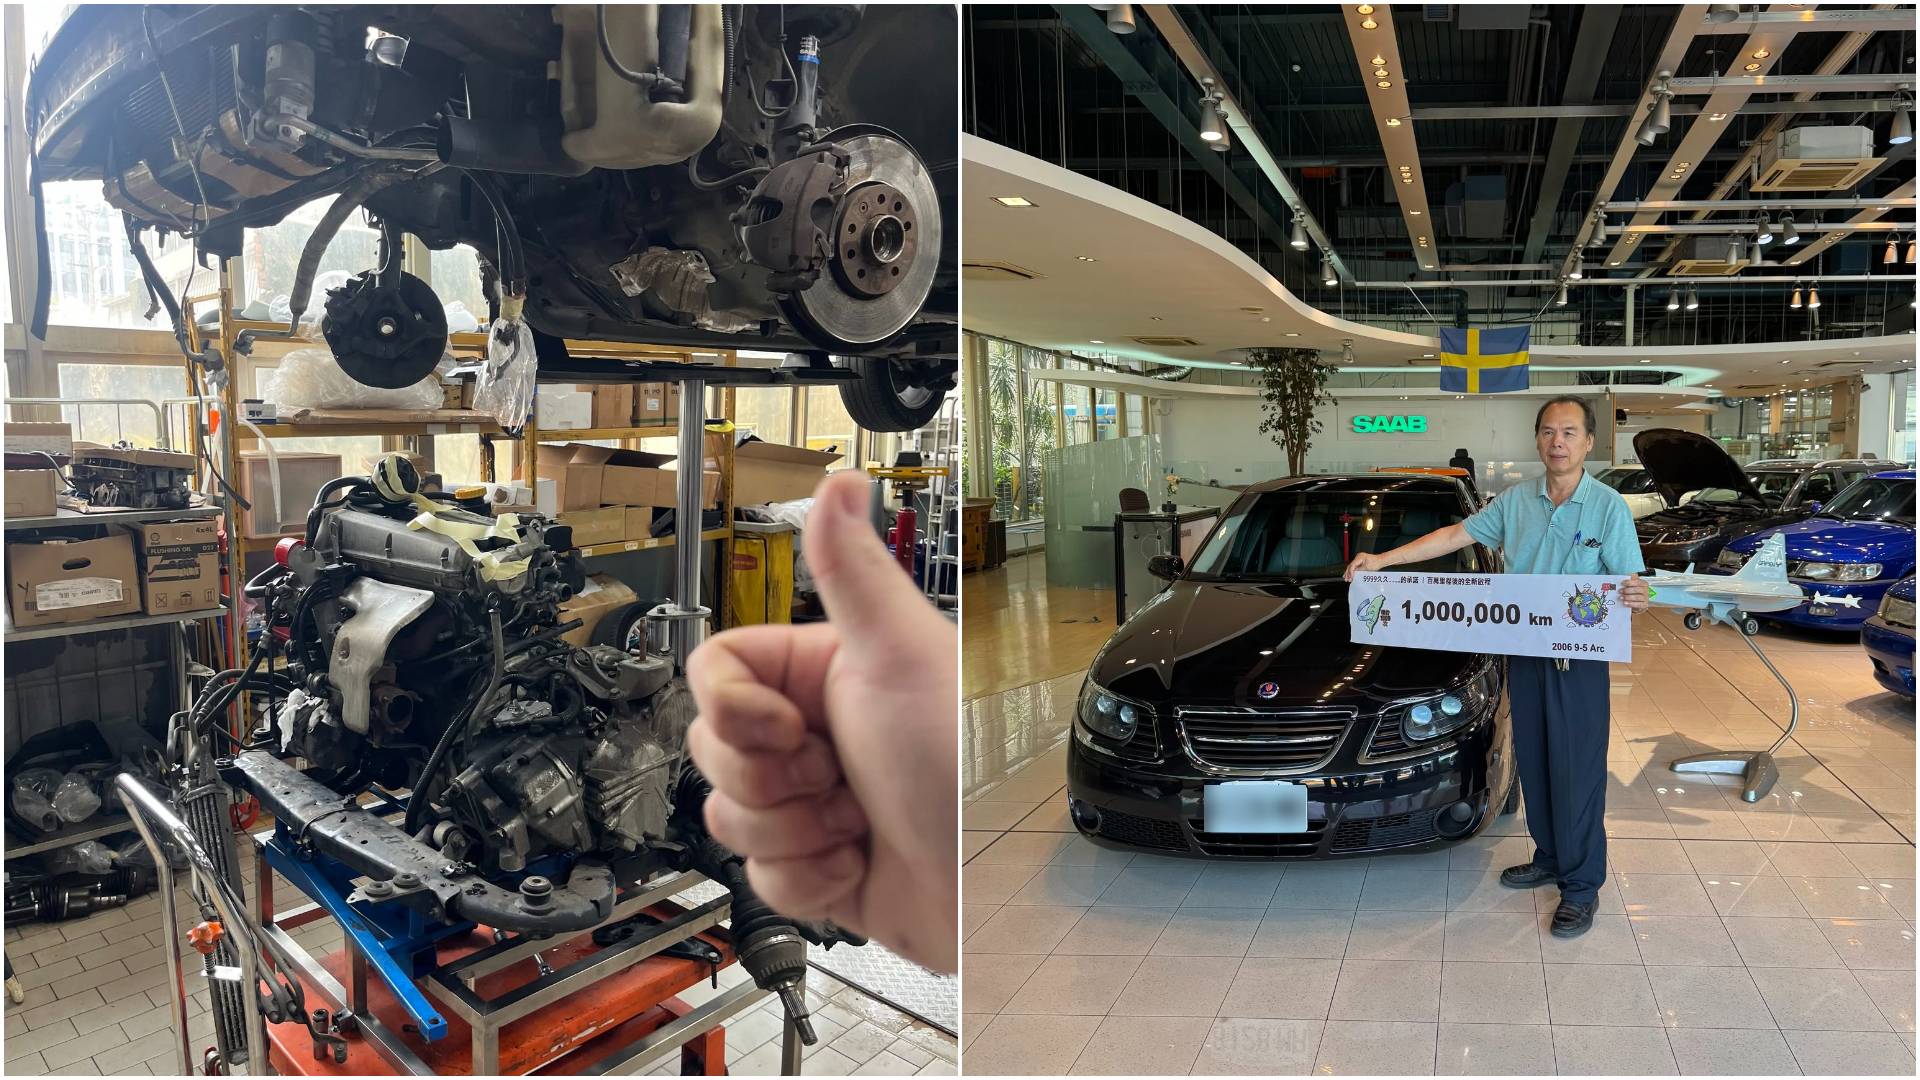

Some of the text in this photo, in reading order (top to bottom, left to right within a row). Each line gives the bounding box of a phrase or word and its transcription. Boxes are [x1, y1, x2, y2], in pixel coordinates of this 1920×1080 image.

[1353, 415, 1427, 433] SAAB
[1401, 600, 1552, 627] 1,000,000 km
[1552, 643, 1572, 651] 2006
[1590, 644, 1605, 652] Arc
